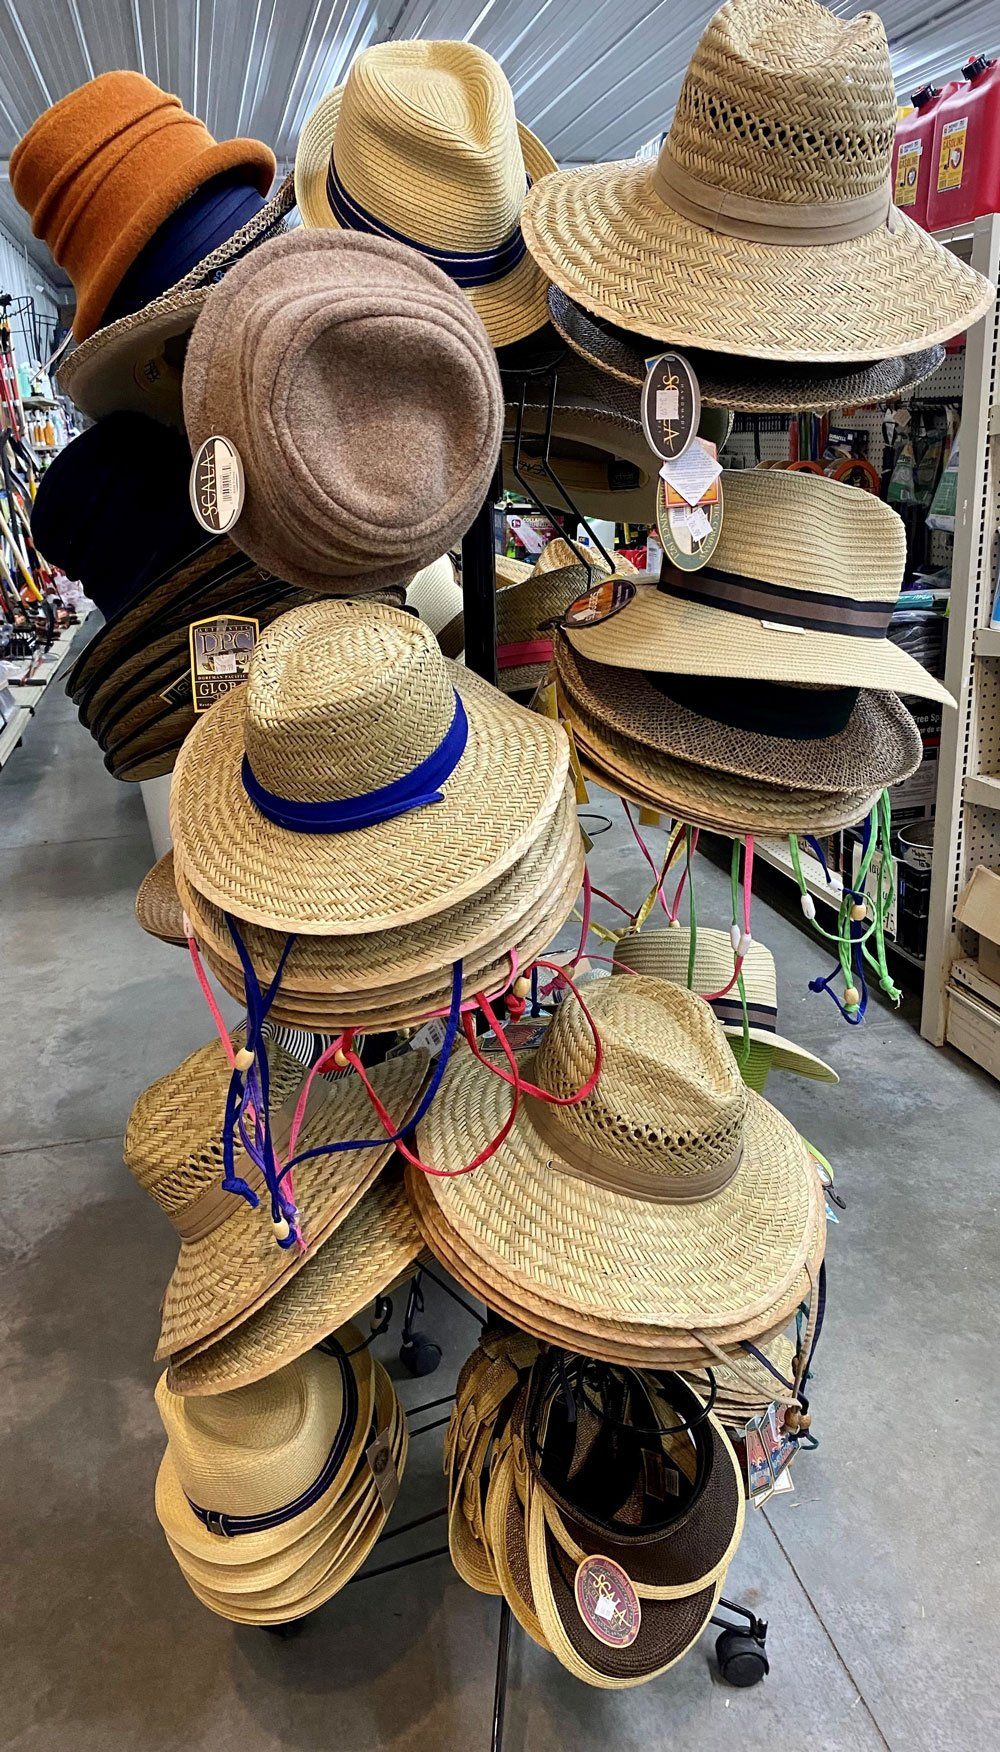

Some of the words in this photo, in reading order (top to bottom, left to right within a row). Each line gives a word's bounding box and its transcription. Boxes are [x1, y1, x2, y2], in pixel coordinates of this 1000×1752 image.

[200, 450, 219, 520] SCALA
[659, 513, 671, 540] SINCE
[666, 539, 680, 560] 1921
[200, 632, 251, 656] DPC
